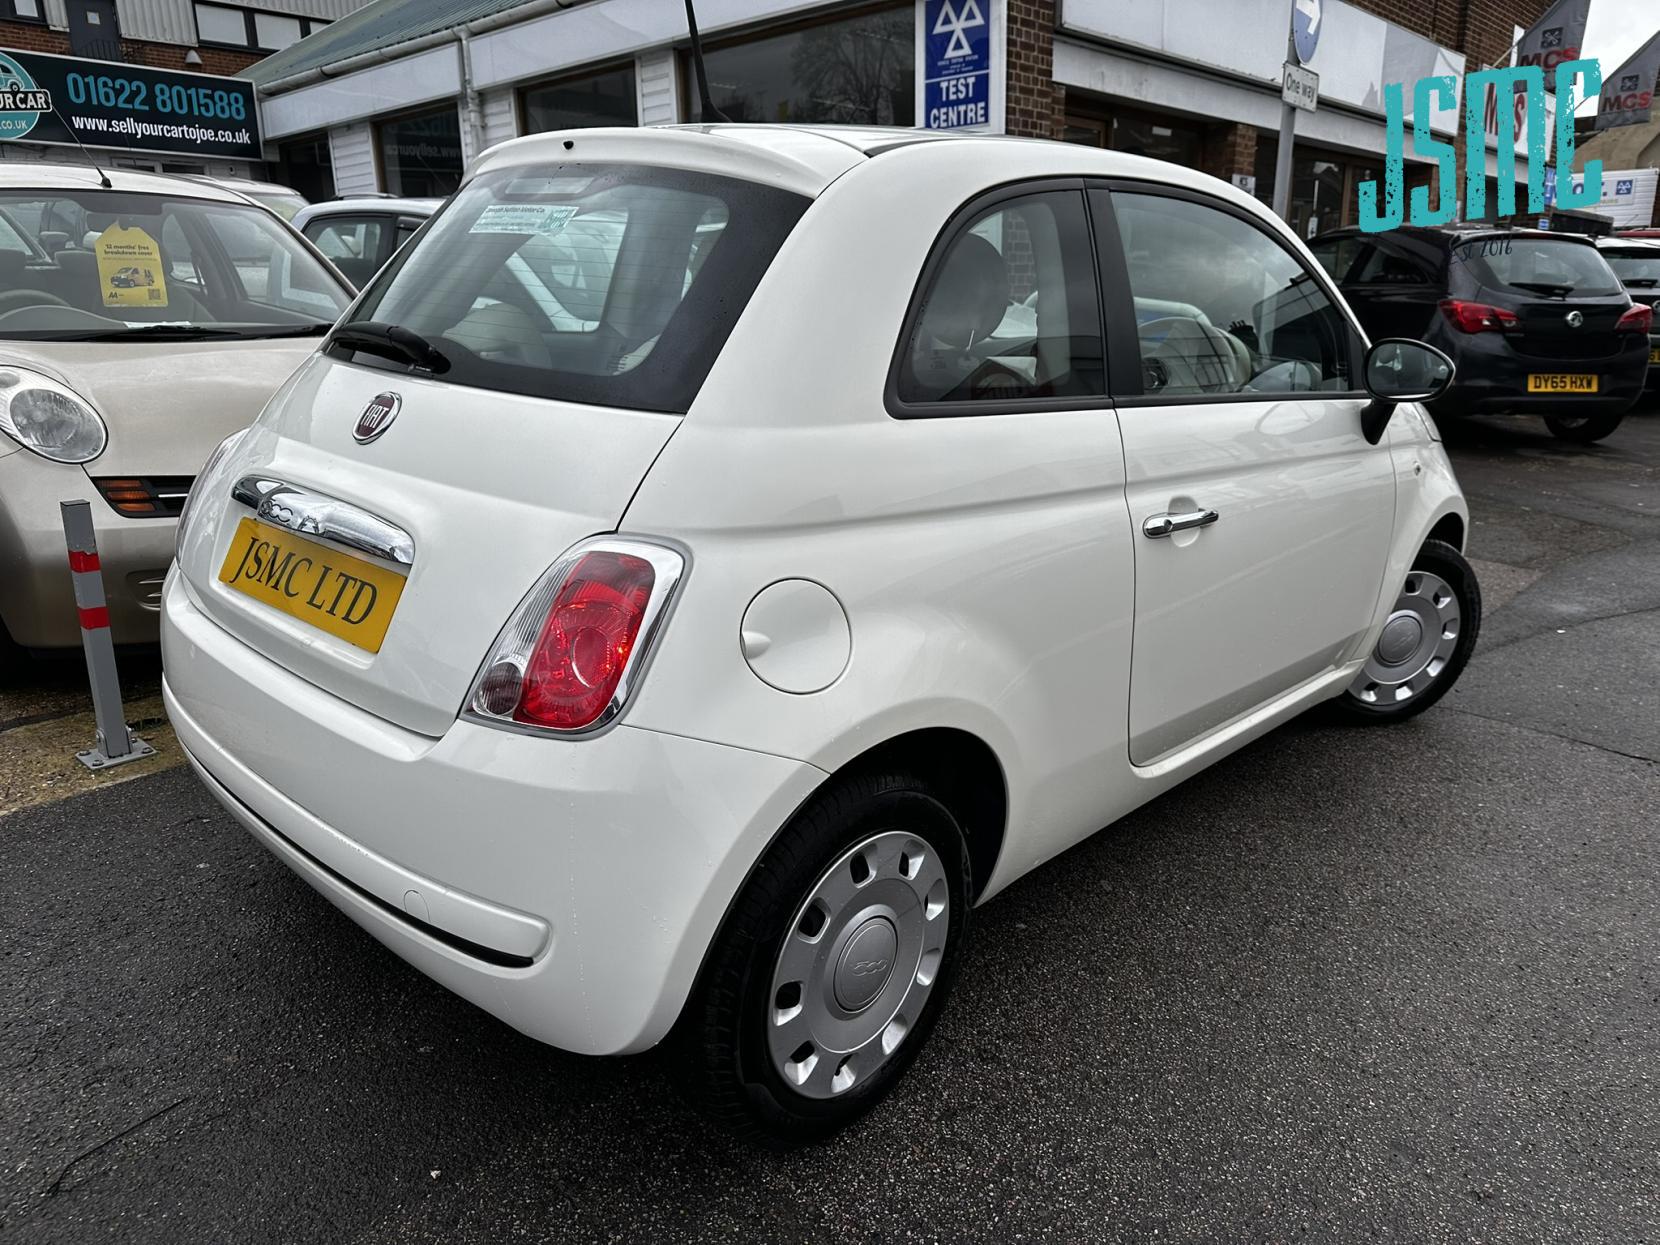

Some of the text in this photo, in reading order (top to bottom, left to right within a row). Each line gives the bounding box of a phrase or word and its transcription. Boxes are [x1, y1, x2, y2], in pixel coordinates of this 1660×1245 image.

[1520, 47, 1579, 69] MCS
[66, 73, 246, 121] 01622 801588
[940, 76, 976, 102] TEST
[1286, 72, 1316, 103] One way
[16, 93, 47, 109] CAR
[1602, 91, 1653, 112] MCS
[930, 101, 986, 129] CENTRE
[71, 115, 251, 144] www.sellyourcartojoe.co.uk
[1534, 375, 1593, 389] DY65 HXW
[361, 404, 389, 429] FIAT
[229, 536, 377, 625] JSMC LTD
